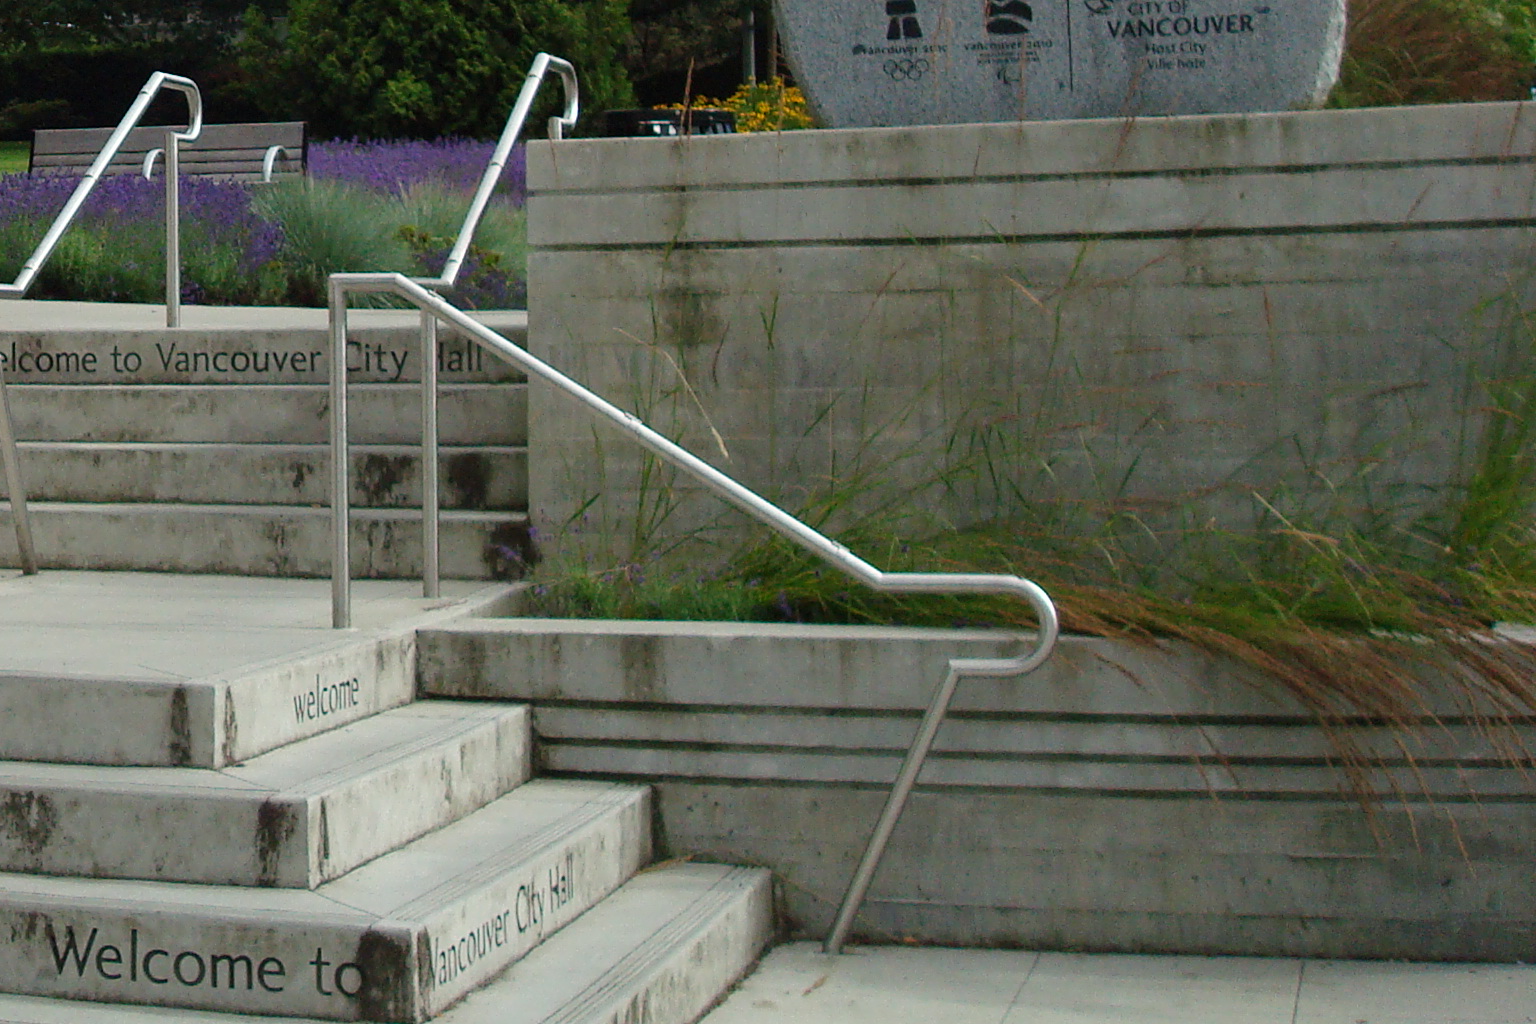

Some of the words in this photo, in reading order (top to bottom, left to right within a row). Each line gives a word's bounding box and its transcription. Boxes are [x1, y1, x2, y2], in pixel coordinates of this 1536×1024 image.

[1106, 14, 1254, 38] VANCOUVER
[1127, 1, 1163, 16] CITY
[1168, 0, 1188, 14] OF
[110, 344, 142, 373] to
[155, 341, 322, 374] Vancouver
[345, 340, 408, 381] City
[293, 673, 359, 724] welcome
[424, 909, 510, 992] Vancouver
[516, 880, 545, 938] City
[548, 852, 574, 914] Hall
[46, 923, 286, 993] Welcome
[309, 947, 365, 997] to
